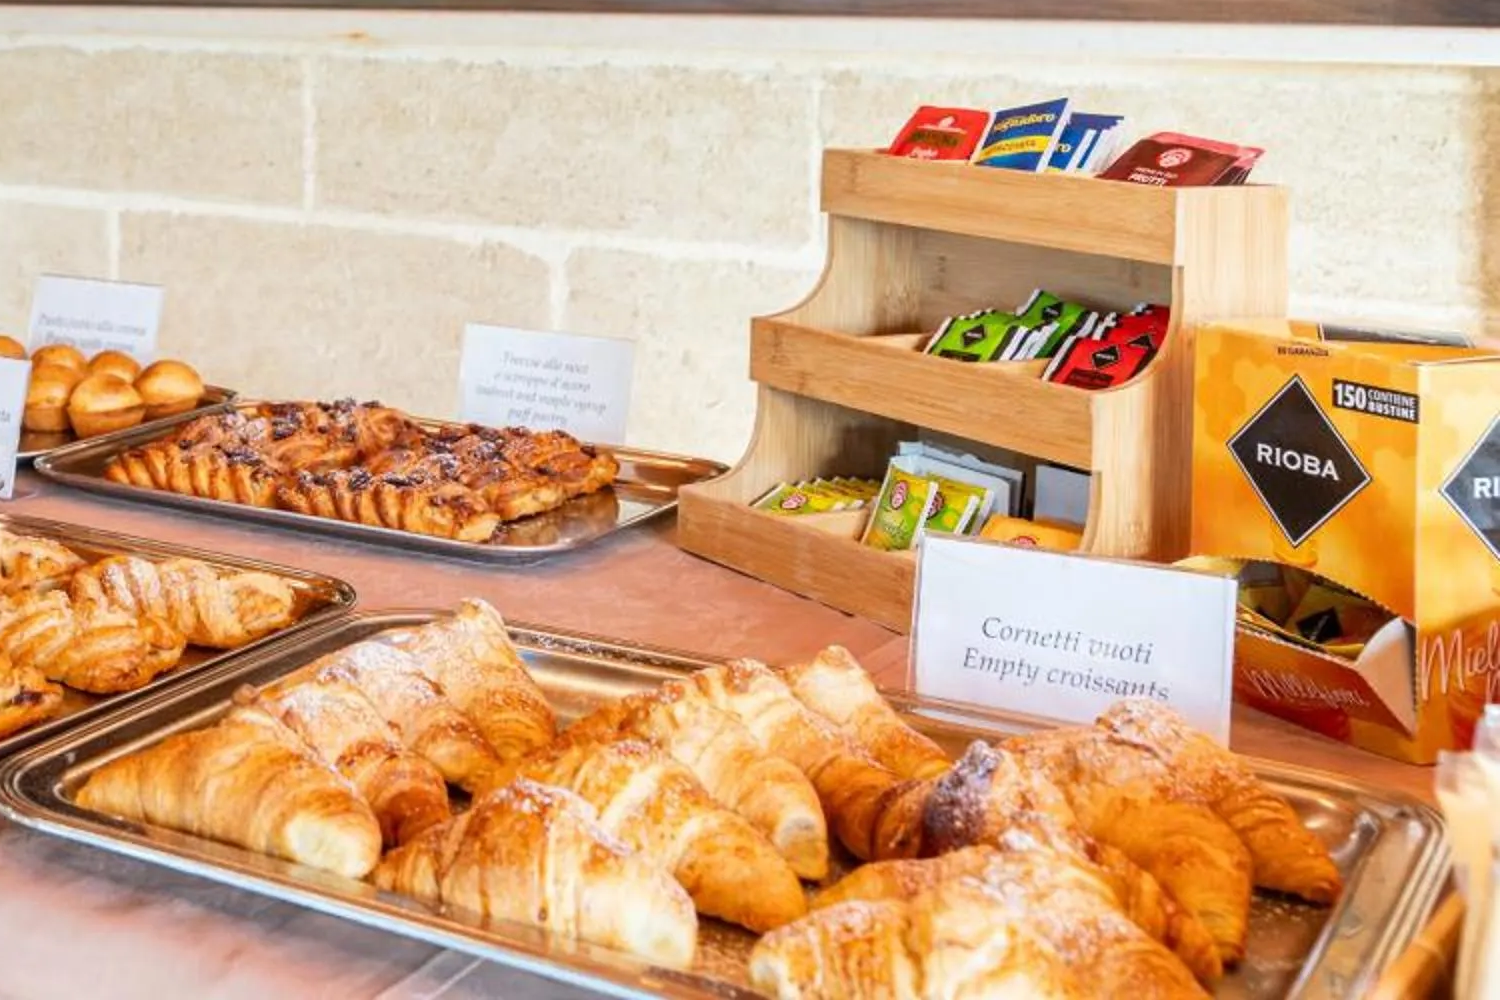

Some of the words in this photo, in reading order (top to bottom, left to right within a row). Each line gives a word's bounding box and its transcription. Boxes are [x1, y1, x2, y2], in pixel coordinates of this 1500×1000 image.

[1334, 383, 1367, 409] 150
[1367, 389, 1416, 408] CONTIENE
[1367, 401, 1416, 421] BUSTINE
[1256, 442, 1340, 481] RIOBA
[981, 616, 1083, 653] Cornetti
[1088, 638, 1154, 665] vuoti
[962, 647, 1040, 687] Empty
[1046, 667, 1171, 701] croissants
